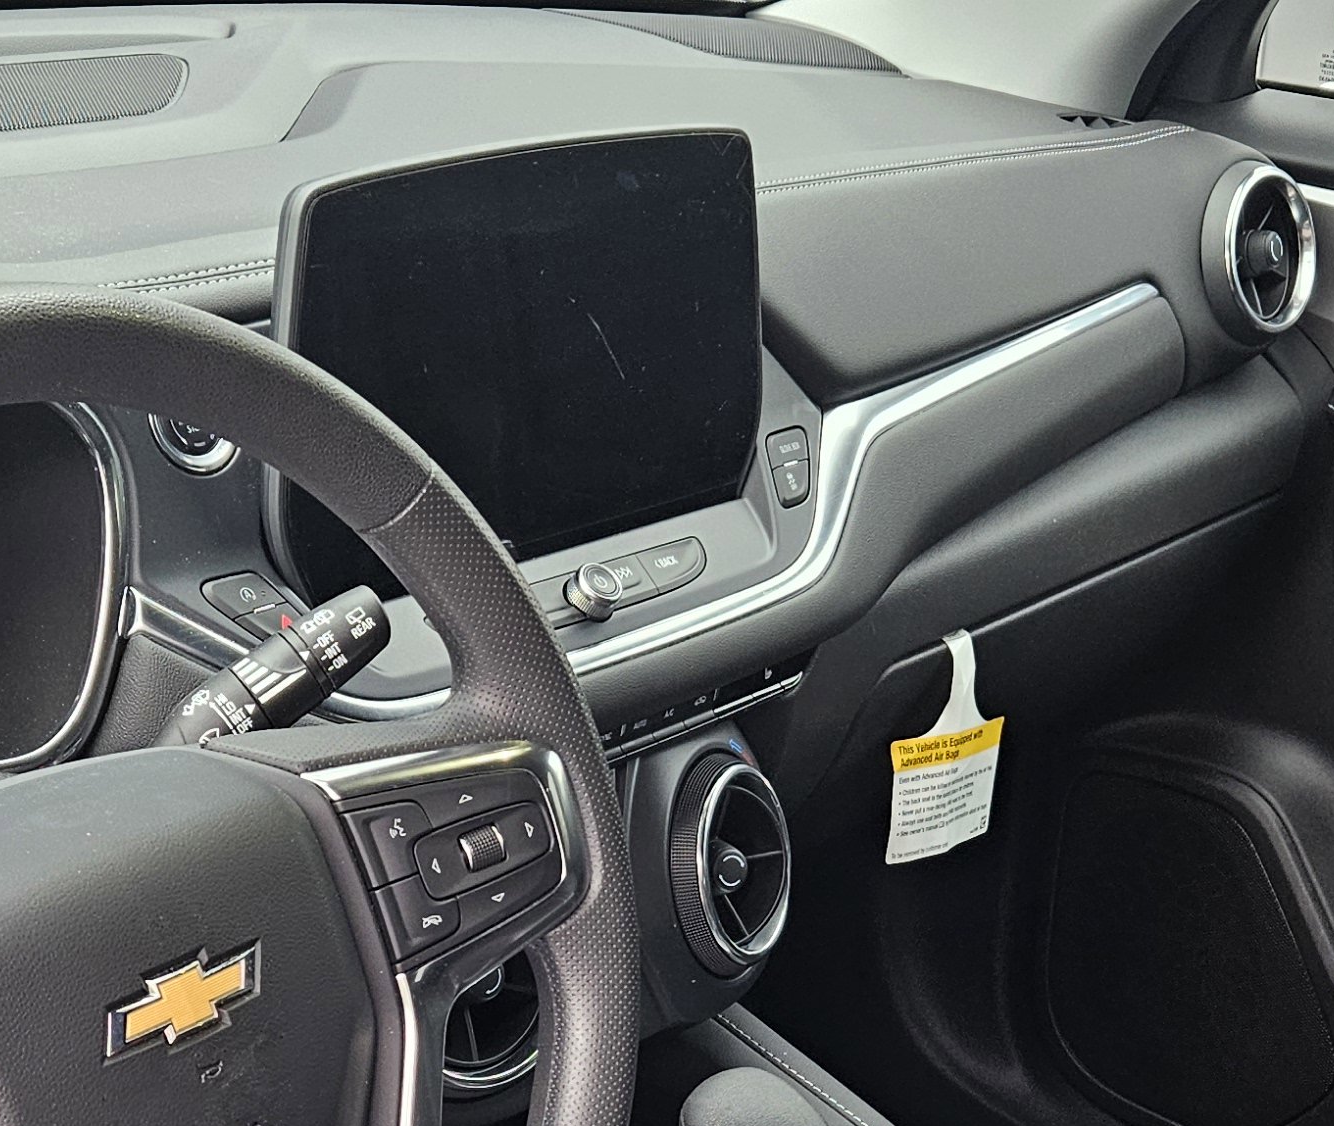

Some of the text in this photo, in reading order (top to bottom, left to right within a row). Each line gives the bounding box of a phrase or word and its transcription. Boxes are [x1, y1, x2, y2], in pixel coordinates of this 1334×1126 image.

[351, 617, 376, 640] REAR
[319, 631, 335, 648] OFF
[325, 642, 342, 660] INT
[333, 654, 348, 669] ON
[221, 701, 237, 716] LO
[229, 707, 246, 726] INT
[237, 716, 253, 734] OFF
[898, 745, 914, 755] This
[915, 741, 940, 752] Vehicle
[941, 739, 948, 748] is
[949, 733, 973, 746] Equipped
[900, 753, 933, 767] Advanced
[934, 752, 944, 761] Air
